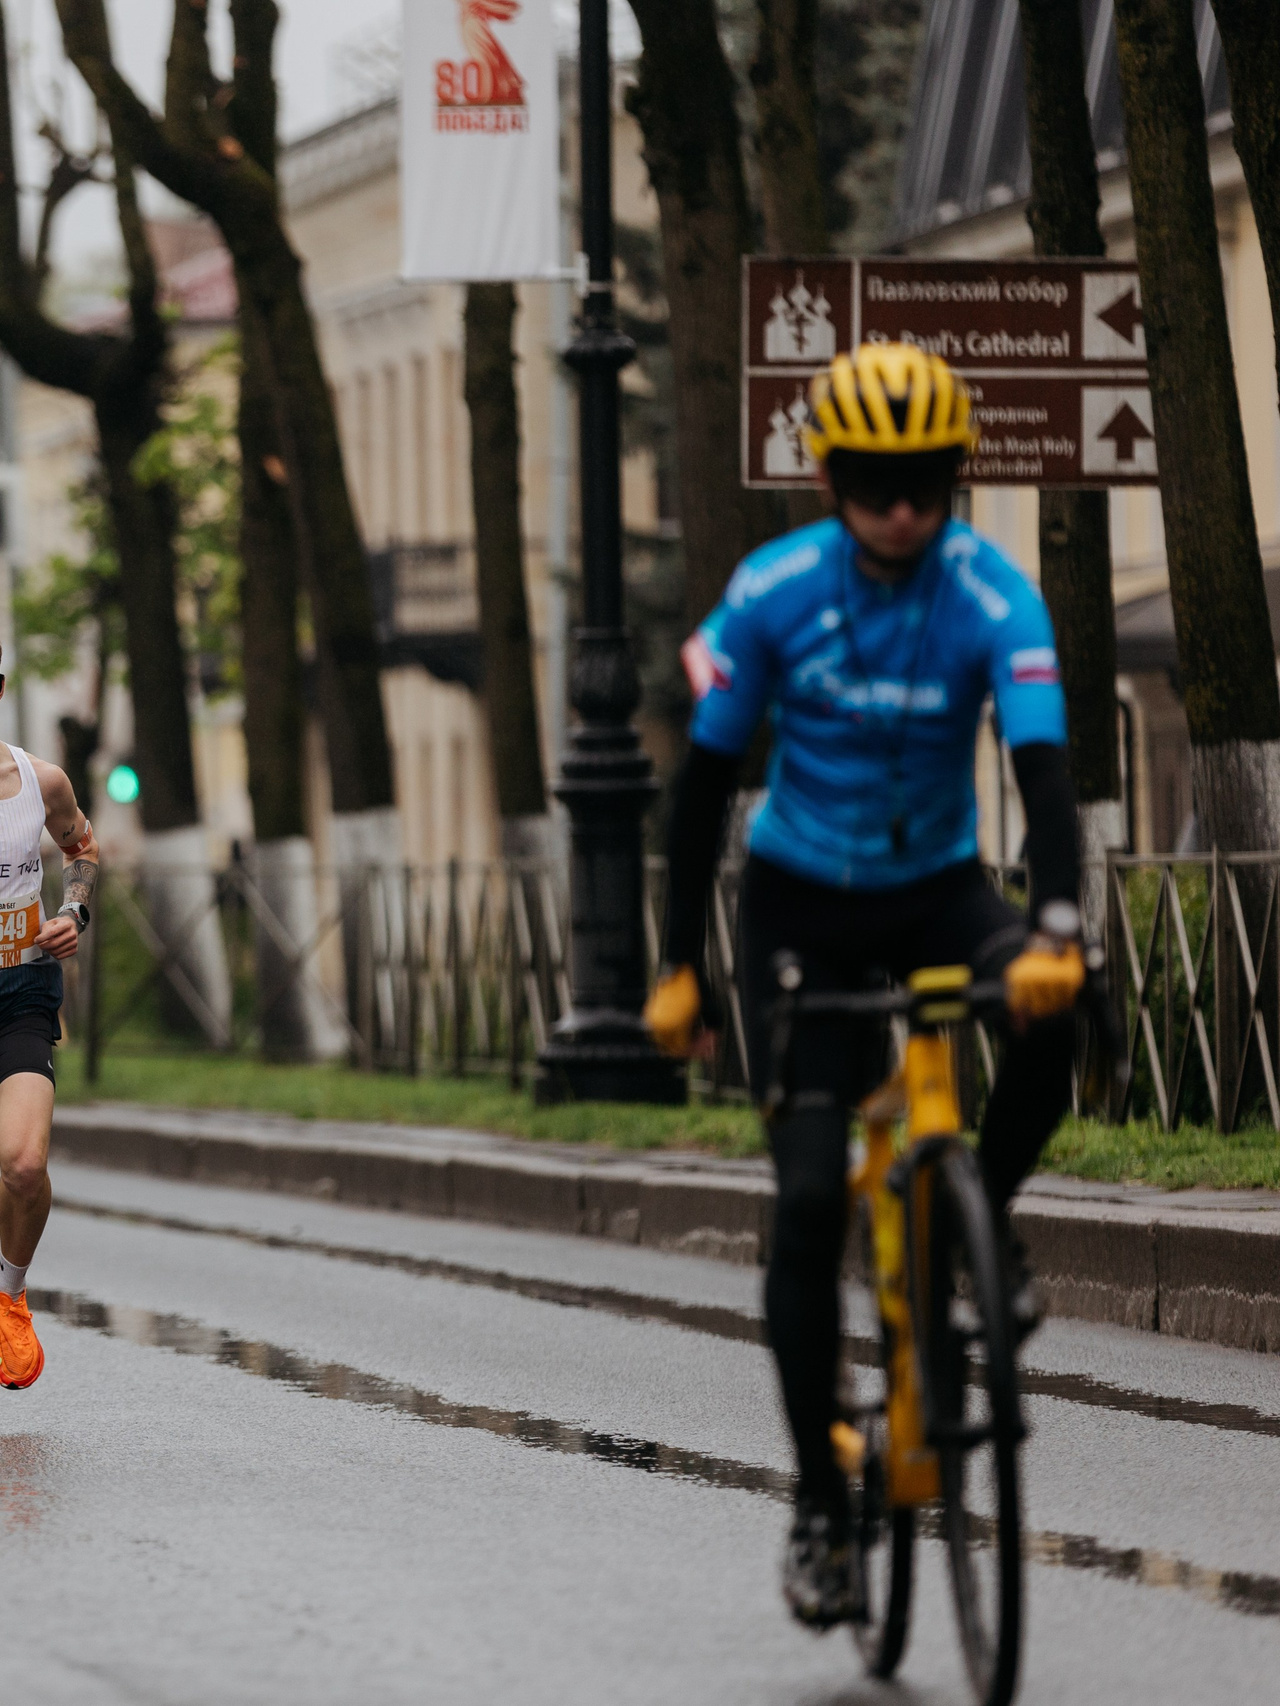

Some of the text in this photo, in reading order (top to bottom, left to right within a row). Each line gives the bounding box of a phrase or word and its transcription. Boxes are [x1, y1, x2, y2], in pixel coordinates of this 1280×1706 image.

[434, 60, 493, 105] 80
[866, 275, 1069, 308] Павловский собор
[965, 329, 1071, 357] Cathedral
[969, 406, 1048, 427] городицы
[979, 436, 1003, 455] the
[1003, 435, 1041, 455] Most
[1042, 435, 1076, 459] Holy
[971, 456, 1043, 476] Cathedral
